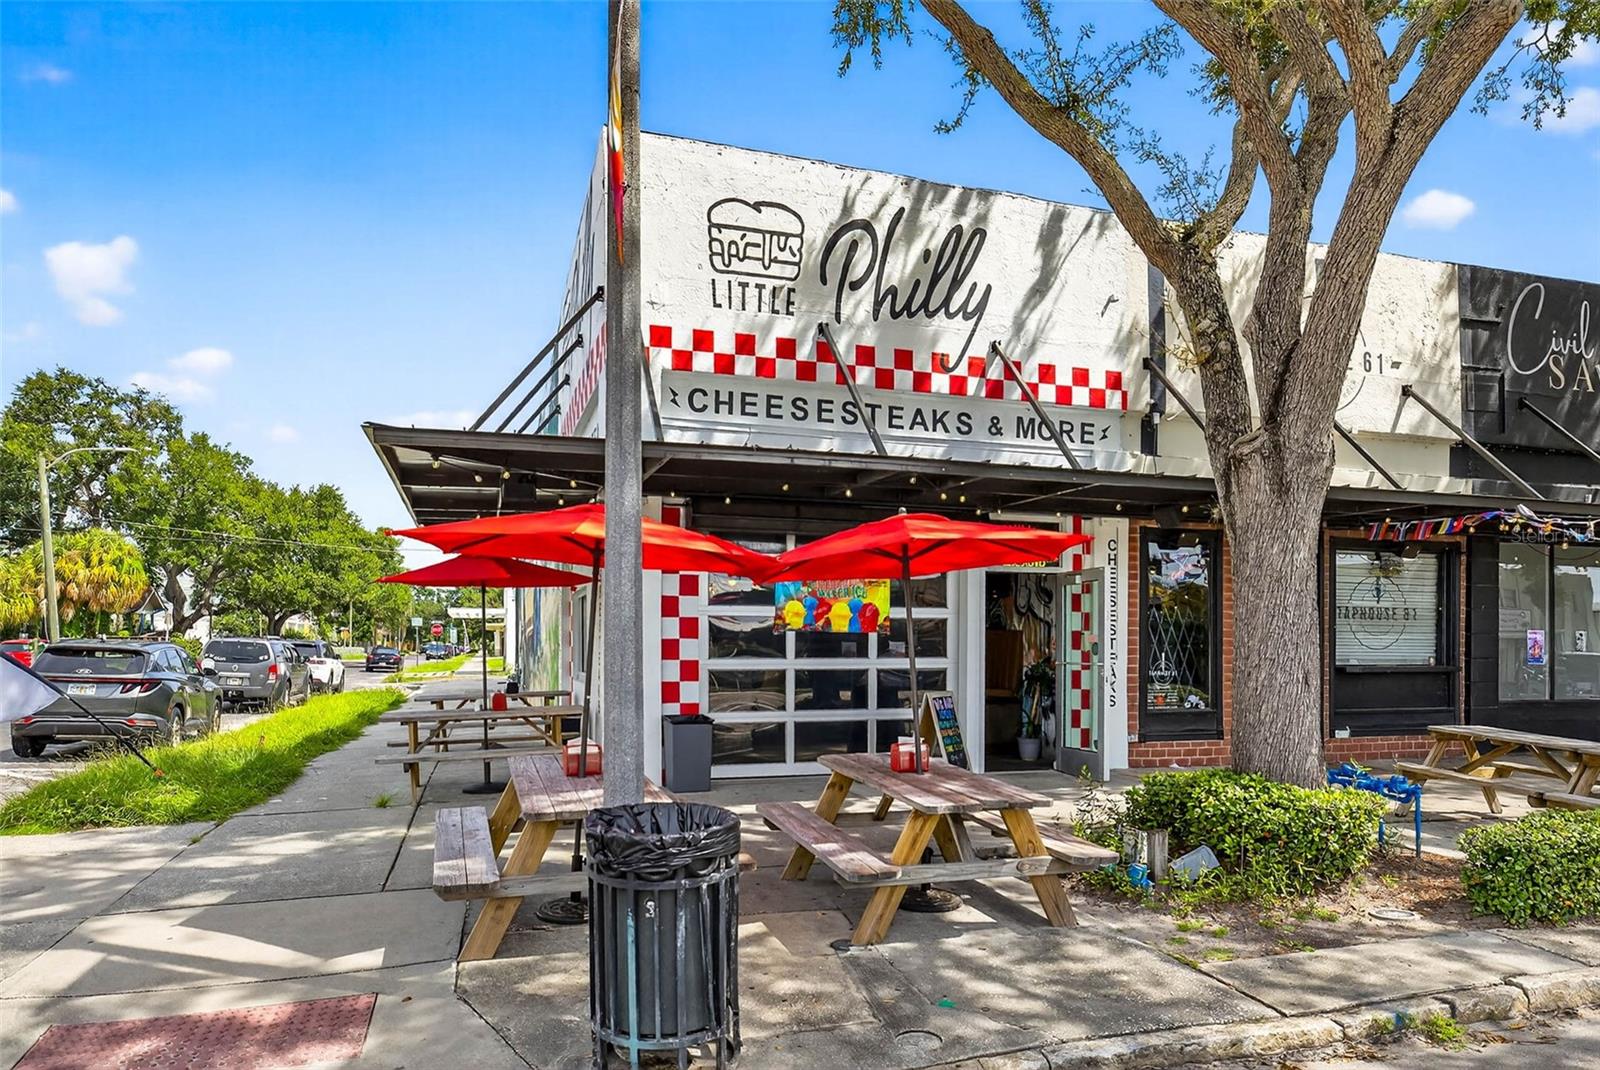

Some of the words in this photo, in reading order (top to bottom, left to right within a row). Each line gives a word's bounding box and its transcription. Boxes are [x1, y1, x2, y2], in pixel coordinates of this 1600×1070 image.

[711, 278, 796, 316] LITTLE
[819, 207, 993, 373] Philly
[1507, 282, 1595, 375] Civil
[1363, 351, 1383, 375] 61
[688, 387, 974, 436] CHEESESTEAKS
[988, 415, 1004, 437] &
[1015, 416, 1095, 445] MORE
[1337, 606, 1398, 621] TAPHOUSE
